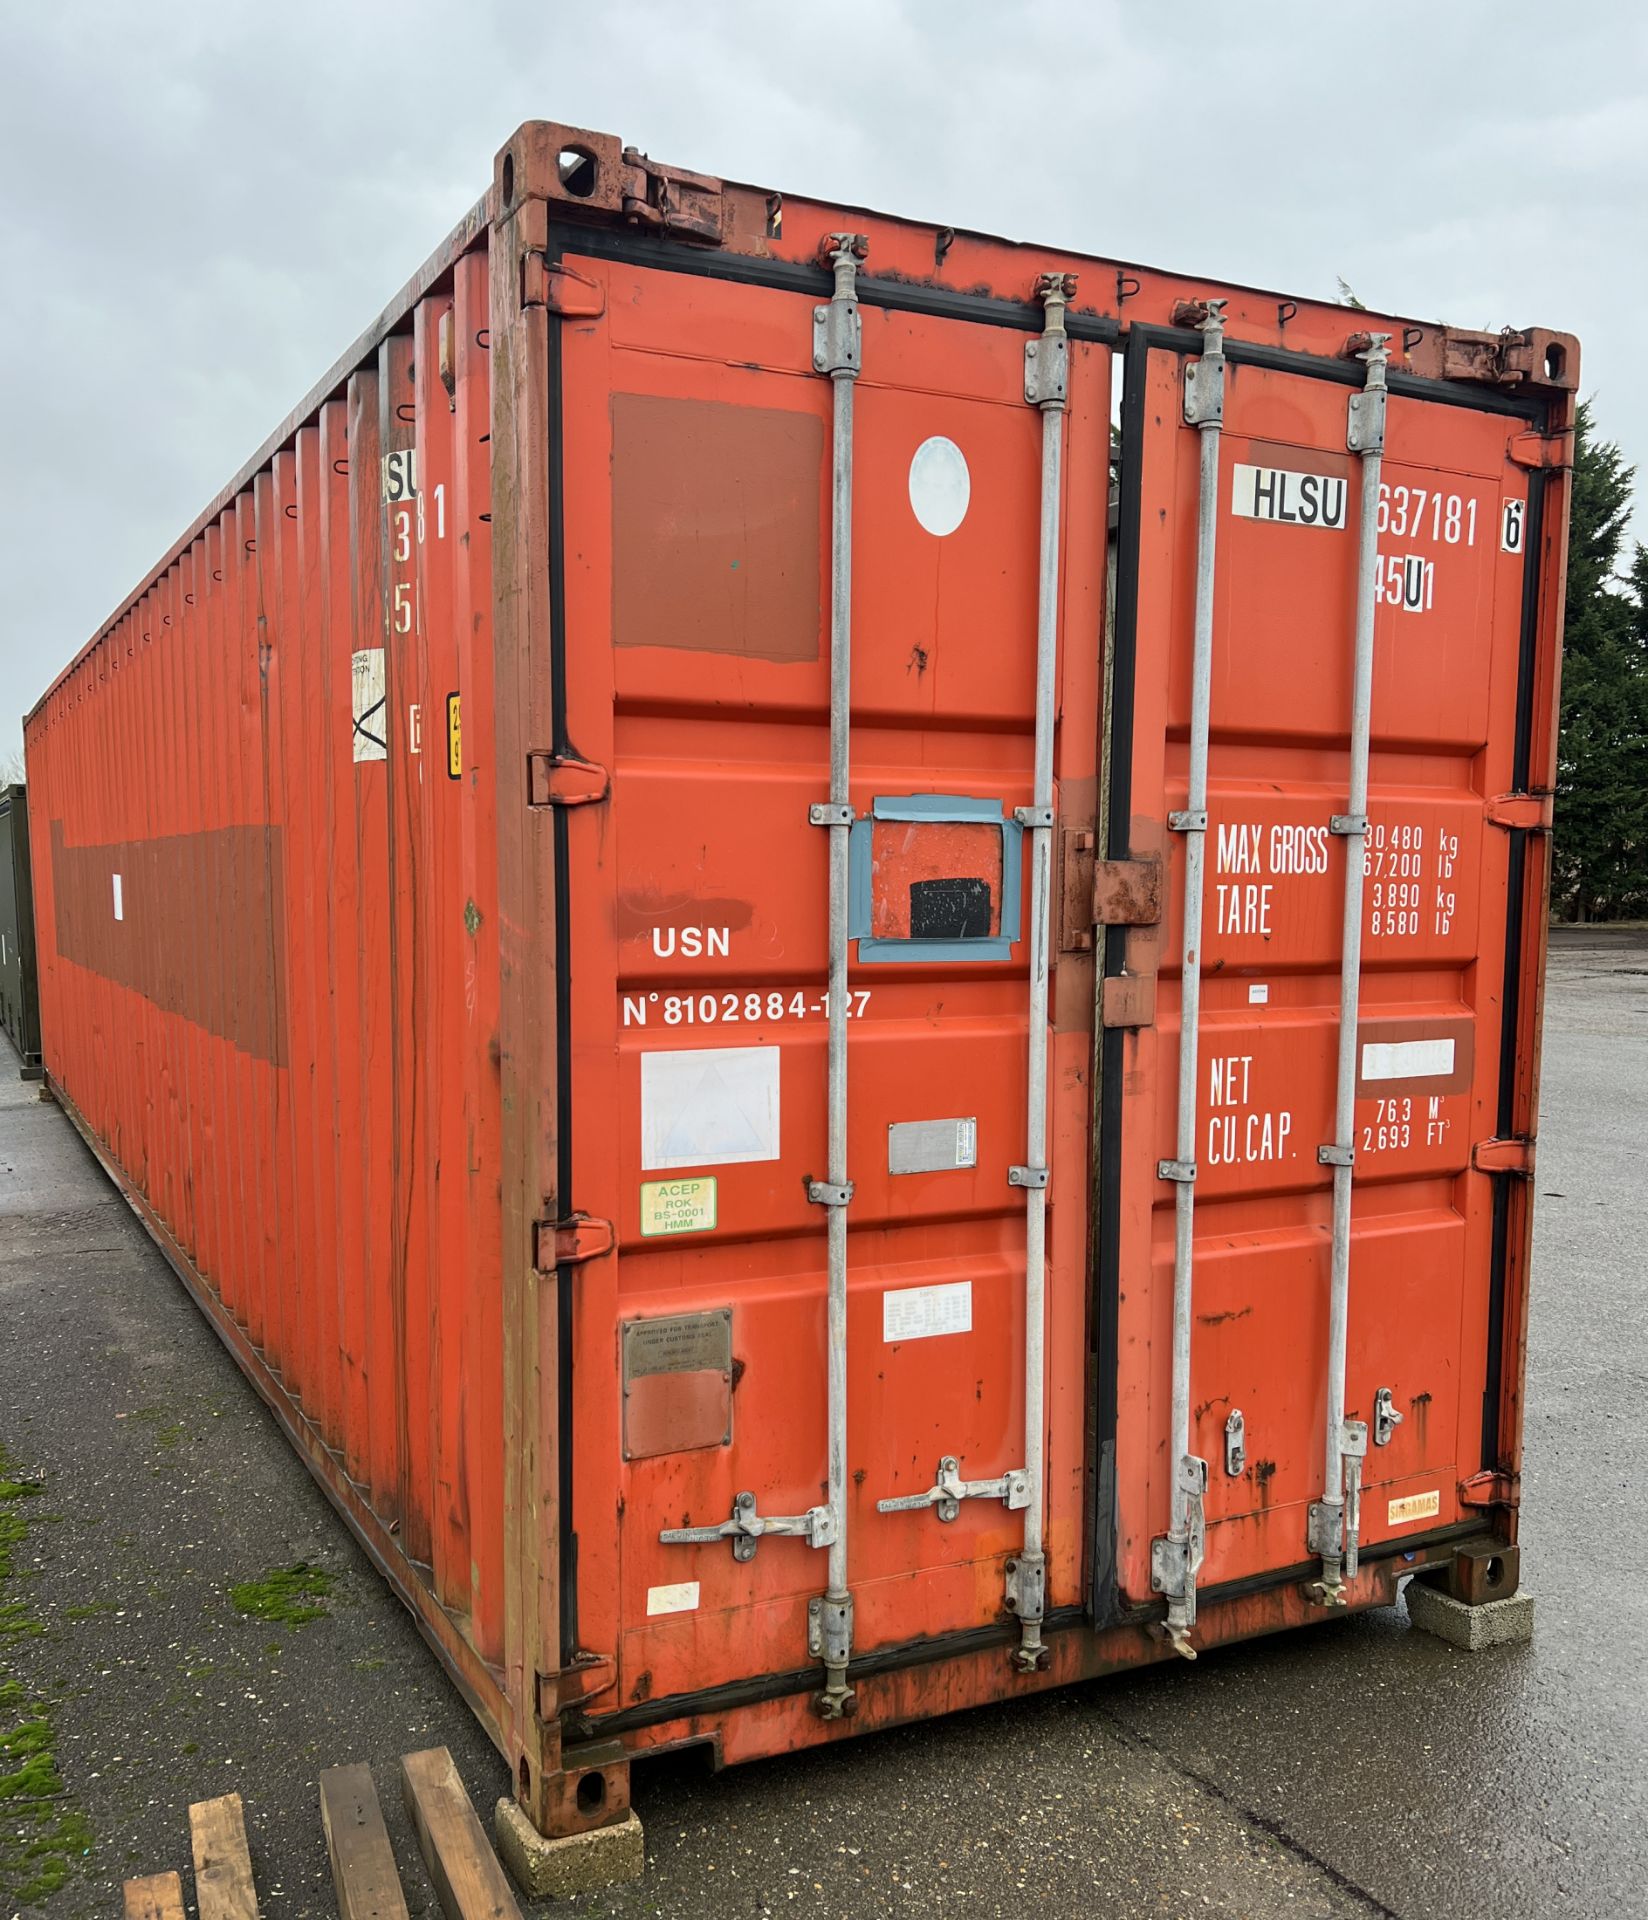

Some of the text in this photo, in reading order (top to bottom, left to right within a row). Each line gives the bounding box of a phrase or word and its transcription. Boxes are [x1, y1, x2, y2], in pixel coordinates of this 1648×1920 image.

[1254, 469, 1343, 527] HLSU
[1377, 483, 1477, 546] 637181
[1374, 555, 1434, 609] 45U1
[1217, 824, 1328, 874] MAX GROSS
[1364, 825, 1458, 859] 30,480 kg
[1363, 852, 1452, 879] 67,200 lb
[1217, 884, 1273, 934] TARE
[1373, 883, 1455, 916] 3,890 kg
[1371, 911, 1449, 937] 8,580 lb
[653, 927, 730, 958] USN
[1210, 1056, 1252, 1107] NET
[1376, 1098, 1411, 1124] 76.3
[1208, 1112, 1296, 1165] CU.CAP.
[1363, 1124, 1410, 1154] 2,693
[658, 1183, 700, 1197] ACEP
[665, 1199, 691, 1209] ROK
[654, 1208, 704, 1220] BS-0001
[664, 1219, 693, 1230] HMM
